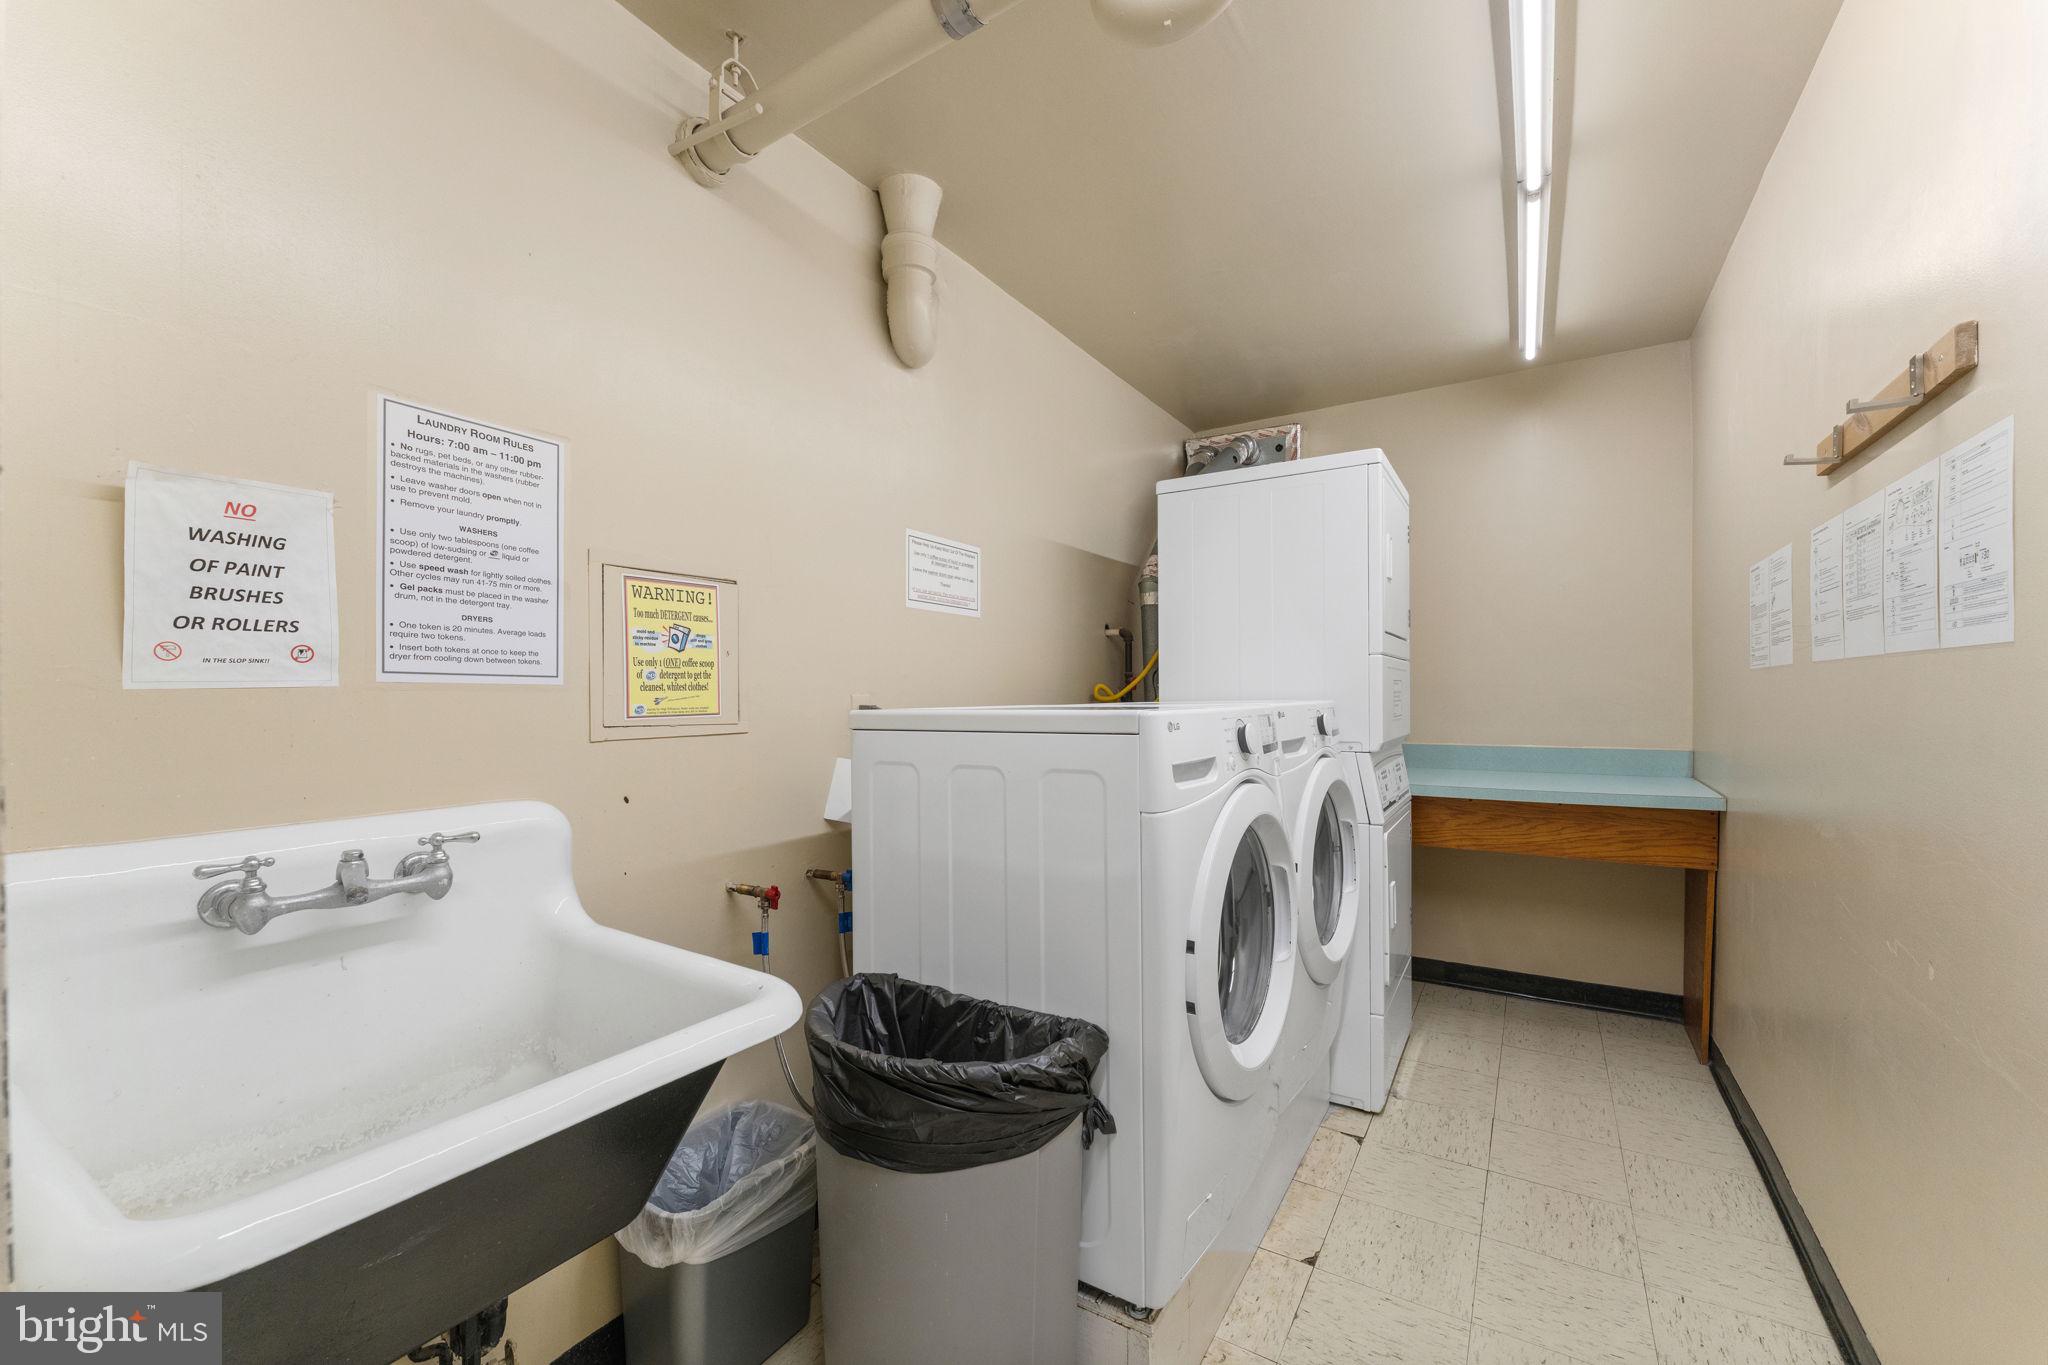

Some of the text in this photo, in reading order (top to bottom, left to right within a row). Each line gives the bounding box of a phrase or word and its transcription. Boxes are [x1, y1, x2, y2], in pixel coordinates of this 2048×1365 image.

[417, 414, 534, 452] LAUNDRY ROOM RULES
[407, 429, 444, 445] Hours:
[447, 438, 470, 451] 7:00
[472, 446, 488, 456] am
[499, 452, 524, 464] 11:00
[526, 460, 541, 468] pm
[390, 459, 426, 473] destroys
[428, 467, 441, 476] the
[400, 442, 413, 451] No
[437, 452, 450, 460] pet
[484, 463, 498, 472] any
[499, 466, 518, 475] other
[390, 449, 540, 488] backed materials in the washers (rubber
[390, 483, 406, 492] use
[418, 489, 449, 500] prevent
[400, 474, 426, 486] Leave
[427, 482, 457, 492] washer
[458, 487, 480, 497] doors
[481, 492, 502, 501] open
[502, 496, 522, 505] when
[223, 501, 257, 522] NO
[400, 498, 435, 511] Remove
[456, 508, 484, 520] laundry
[188, 526, 287, 550] WASHING
[458, 525, 498, 537] WASHERS
[389, 538, 418, 548] scoop)
[430, 542, 477, 557] low-sudsing
[501, 552, 520, 561] liquid
[399, 527, 540, 555] Use only two tablespoons (one coffee
[389, 547, 431, 558] powdered
[189, 558, 285, 578] OF PAINT
[399, 560, 417, 569] Use
[418, 564, 445, 572] speed
[446, 567, 469, 575] wash
[482, 570, 504, 580] lightly
[389, 568, 414, 578] Other
[415, 572, 441, 581] cycles
[443, 576, 460, 584] may
[476, 579, 497, 587] 41-75
[189, 585, 284, 604] BRUSHES
[399, 582, 415, 591] Gel
[417, 586, 443, 594] packs
[477, 591, 502, 599] placed
[631, 584, 712, 605] WARNING!
[459, 598, 495, 608] detergent
[461, 614, 493, 623] DRYERS
[633, 607, 644, 618] Too
[644, 608, 659, 619] much
[659, 609, 692, 622] DETERGENT
[172, 615, 300, 633] OR ROLLERS
[398, 620, 417, 629] One
[452, 624, 462, 632] 20
[497, 628, 526, 637] Average
[389, 631, 419, 639] require
[389, 652, 411, 661] dryer
[413, 653, 432, 661] from
[433, 655, 462, 664] cooling
[485, 656, 516, 664] between
[399, 643, 422, 651] Insert
[509, 649, 527, 657] keep
[632, 656, 644, 665] Use
[644, 656, 658, 669] only
[681, 657, 698, 668] coffee
[698, 660, 714, 671] scoop
[636, 669, 643, 679] of
[658, 669, 686, 681] detergent
[686, 670, 693, 679] to
[693, 671, 702, 682] get
[702, 670, 712, 679] the
[666, 681, 687, 692] whitest
